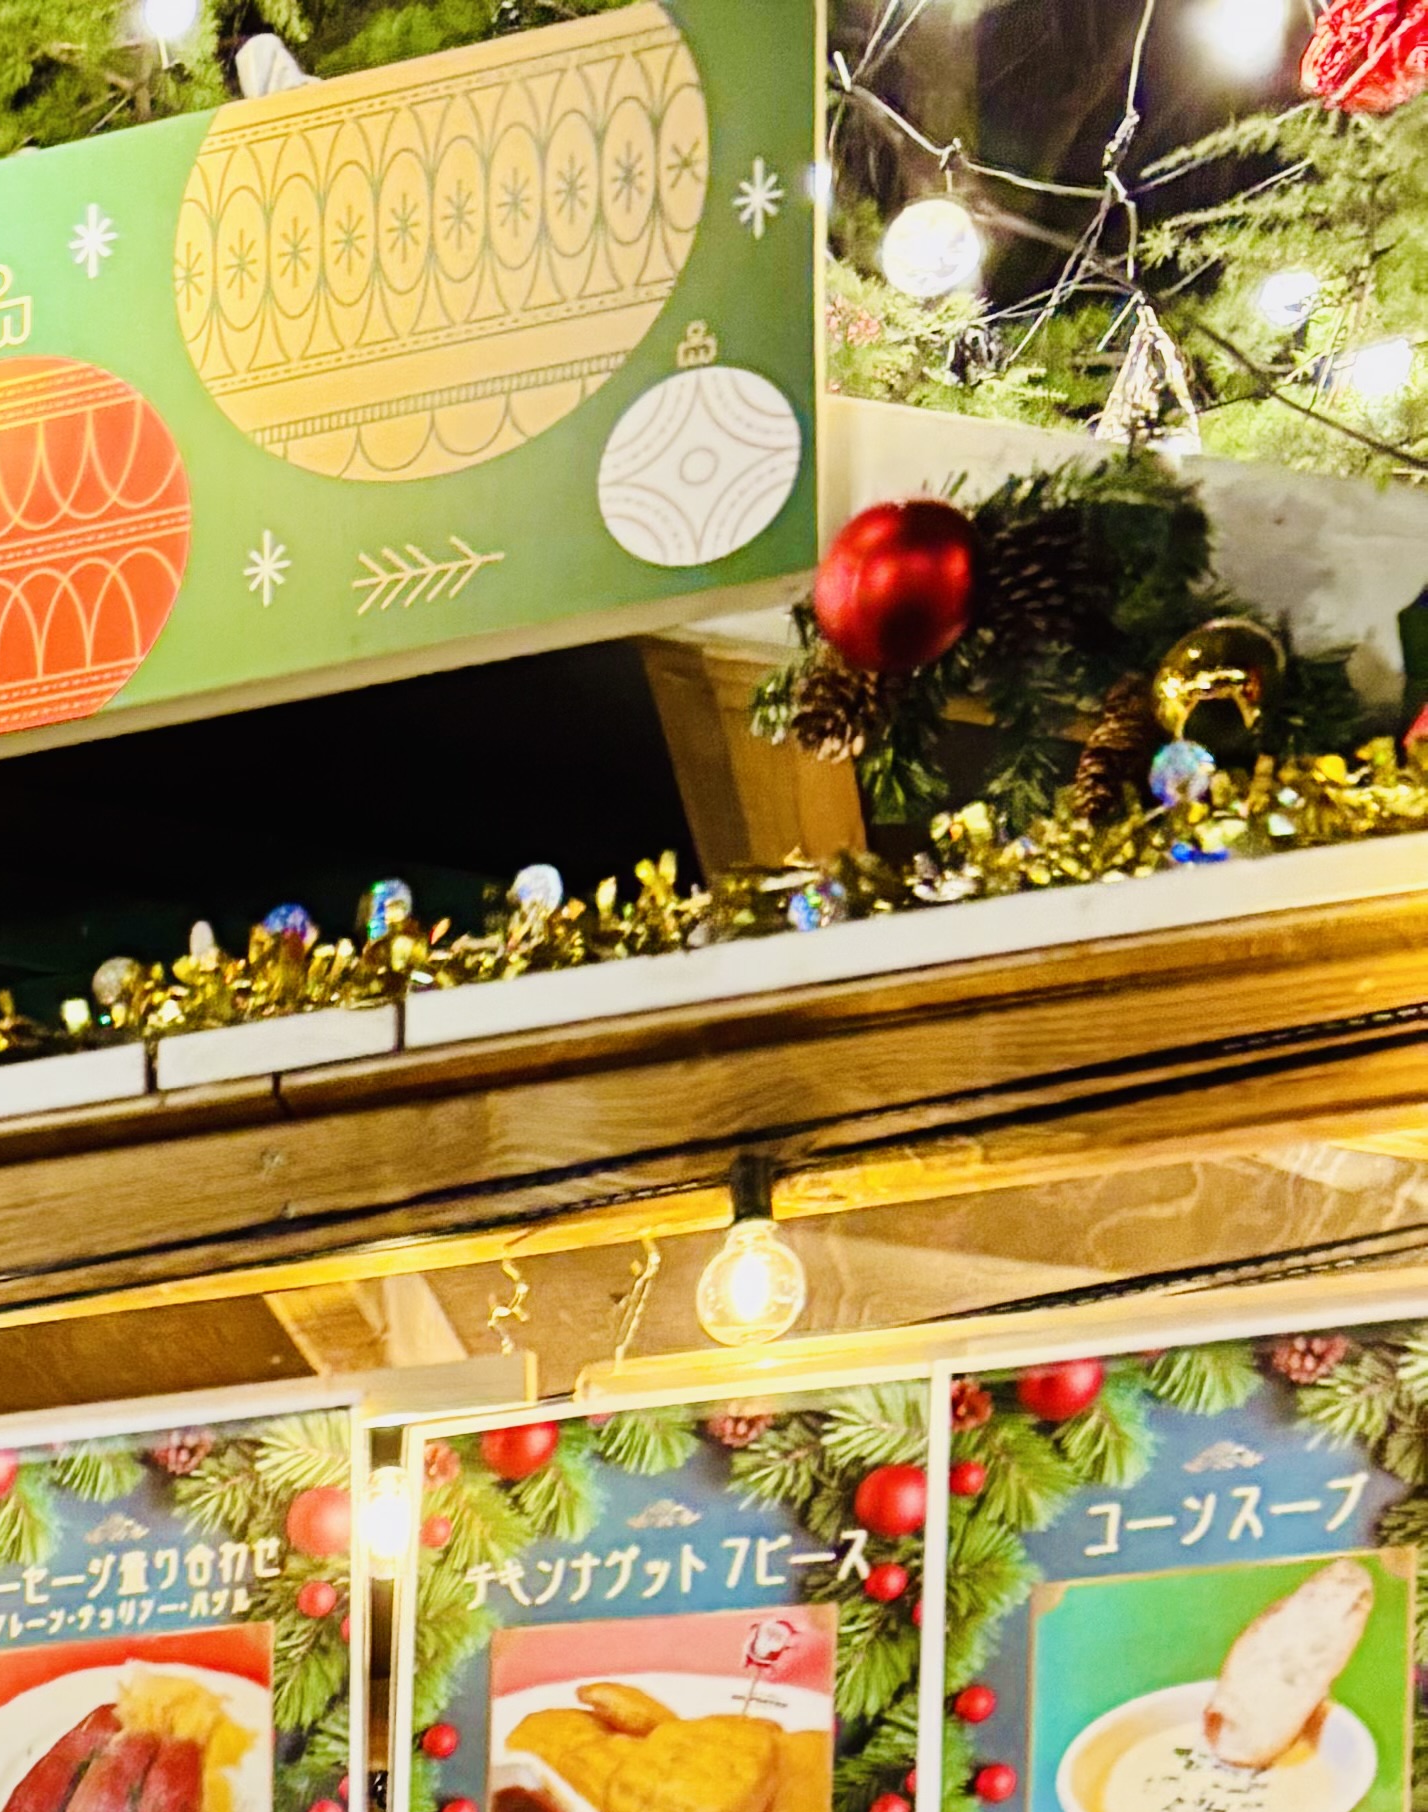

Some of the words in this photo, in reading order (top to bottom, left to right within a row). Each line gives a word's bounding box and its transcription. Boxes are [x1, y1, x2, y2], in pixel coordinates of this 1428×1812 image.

[1082, 1472, 1371, 1557] コーンスープ
